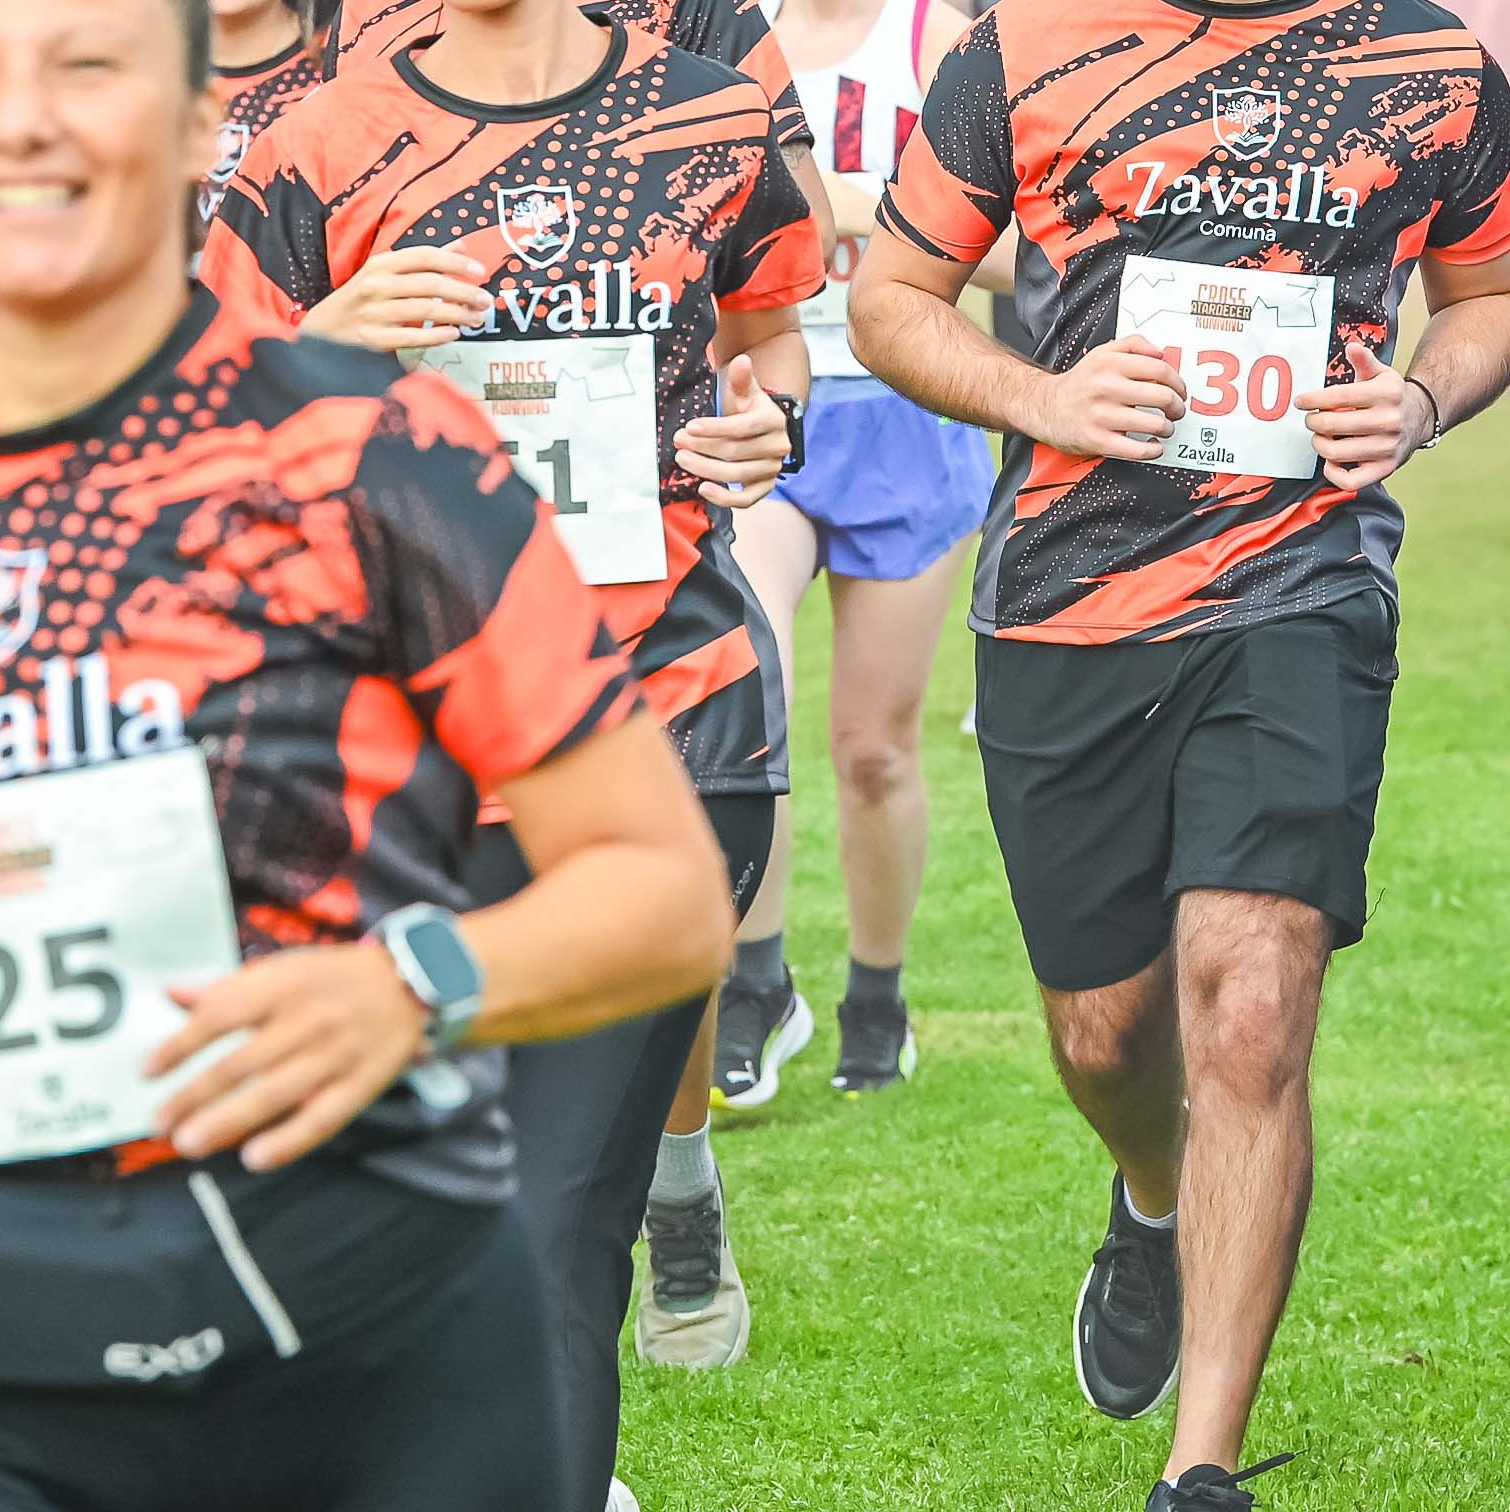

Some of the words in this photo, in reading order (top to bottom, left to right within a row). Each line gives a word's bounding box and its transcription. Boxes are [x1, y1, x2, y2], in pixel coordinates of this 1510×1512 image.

[1126, 161, 1358, 229] Zavalla
[1199, 220, 1277, 242] Comuna
[1197, 283, 1247, 306] CROSS
[1191, 301, 1251, 319] ATARDECER
[1196, 315, 1244, 332] RUNNING
[1177, 444, 1235, 464] Zavalla
[495, 439, 588, 515] 1
